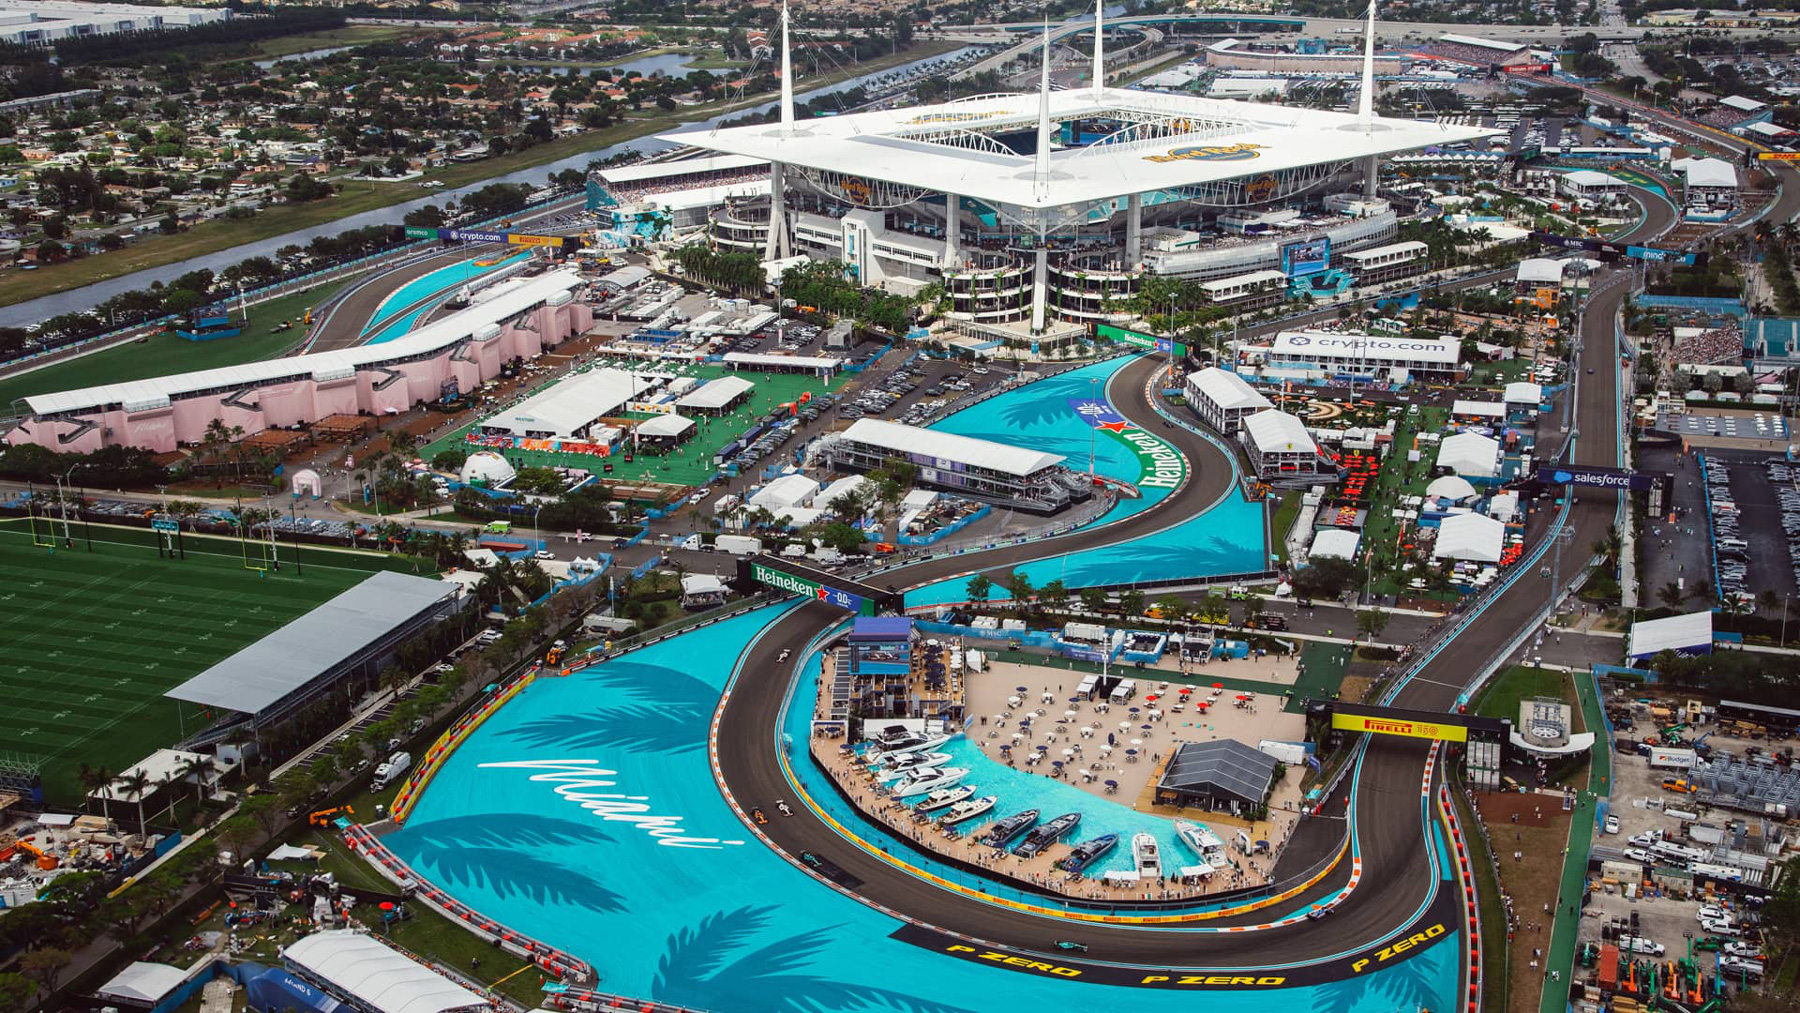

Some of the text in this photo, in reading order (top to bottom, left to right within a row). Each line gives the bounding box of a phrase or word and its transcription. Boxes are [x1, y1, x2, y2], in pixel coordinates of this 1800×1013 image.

[459, 231, 501, 241] crypto.com
[1124, 333, 1153, 347] Heineken
[1318, 338, 1445, 352] crypto.com
[1123, 432, 1182, 488] Heineken
[1574, 472, 1629, 486] salesforce
[756, 566, 813, 597] Heineken
[1364, 719, 1412, 734] PIRELLI
[1667, 755, 1690, 764] Budget
[1351, 923, 1446, 973] P ZERO
[946, 944, 1082, 977] P ZERO
[1141, 975, 1286, 986] P ZERO
